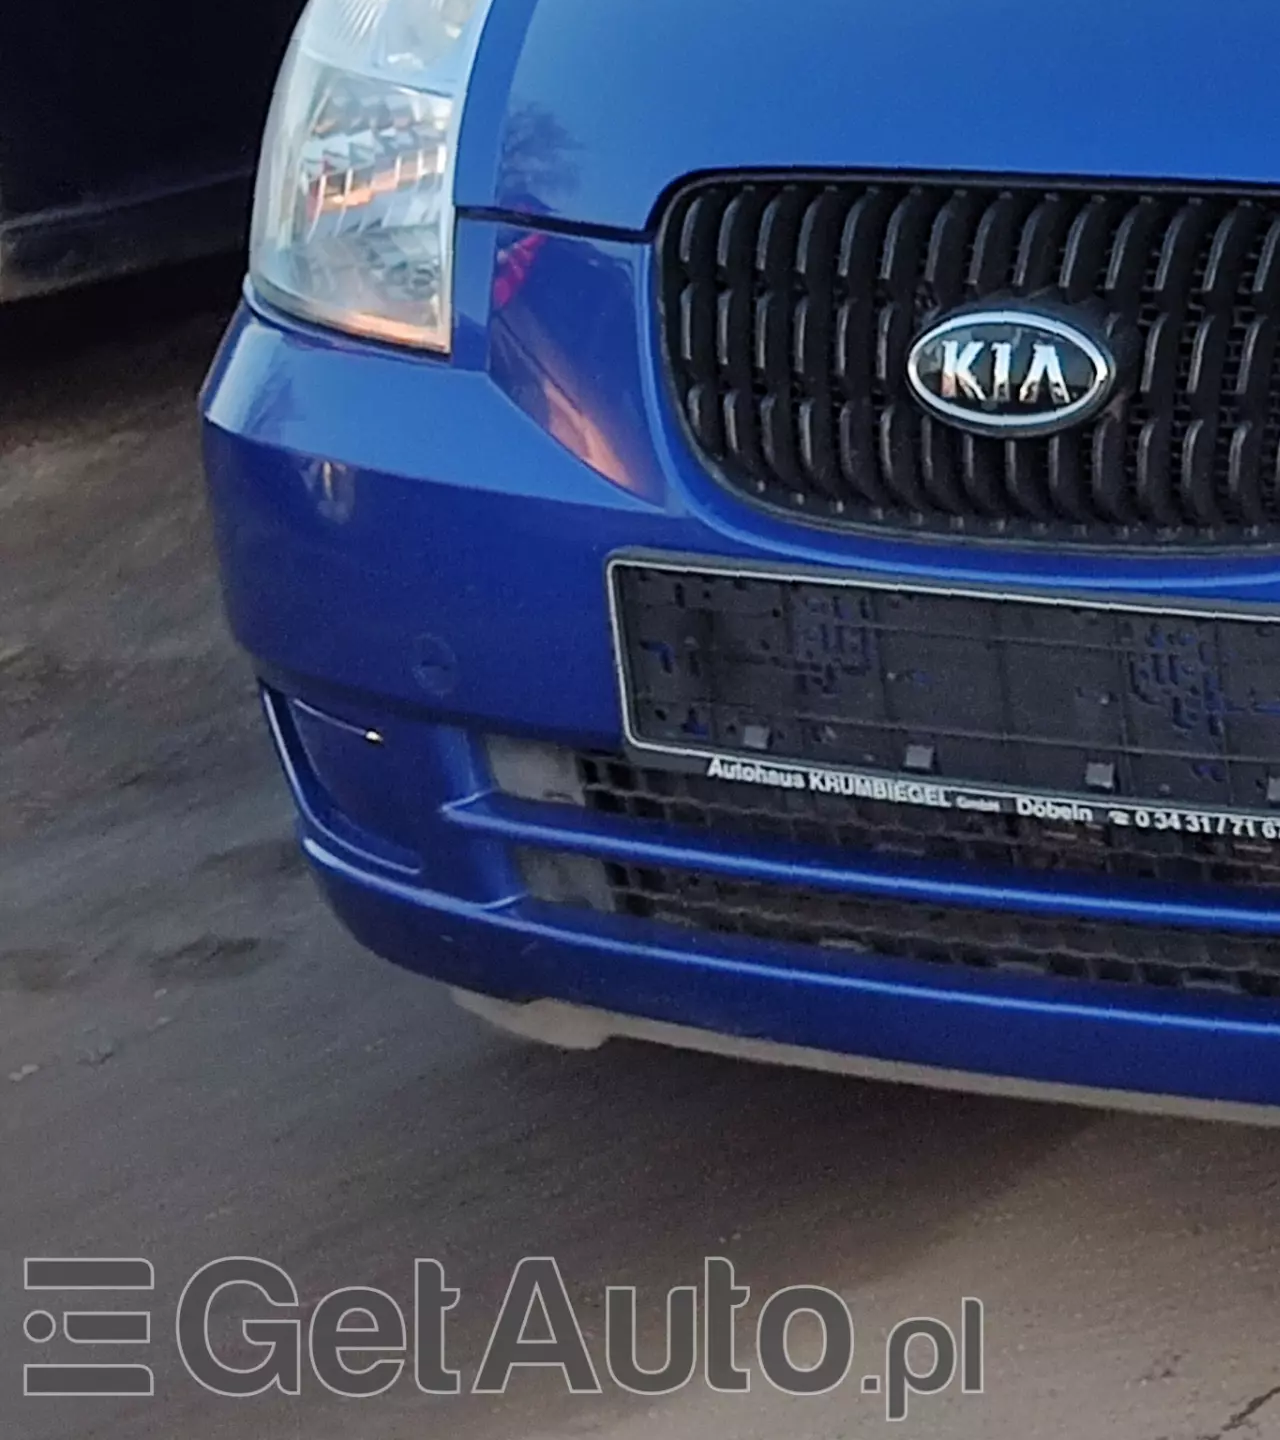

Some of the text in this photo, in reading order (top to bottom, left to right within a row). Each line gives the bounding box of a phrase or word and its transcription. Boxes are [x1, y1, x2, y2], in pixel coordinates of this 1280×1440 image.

[941, 340, 1070, 403] KIA
[707, 756, 804, 788] Autohaus
[809, 771, 952, 808] KRUMBIEGEL
[1016, 797, 1094, 822] Döbeln
